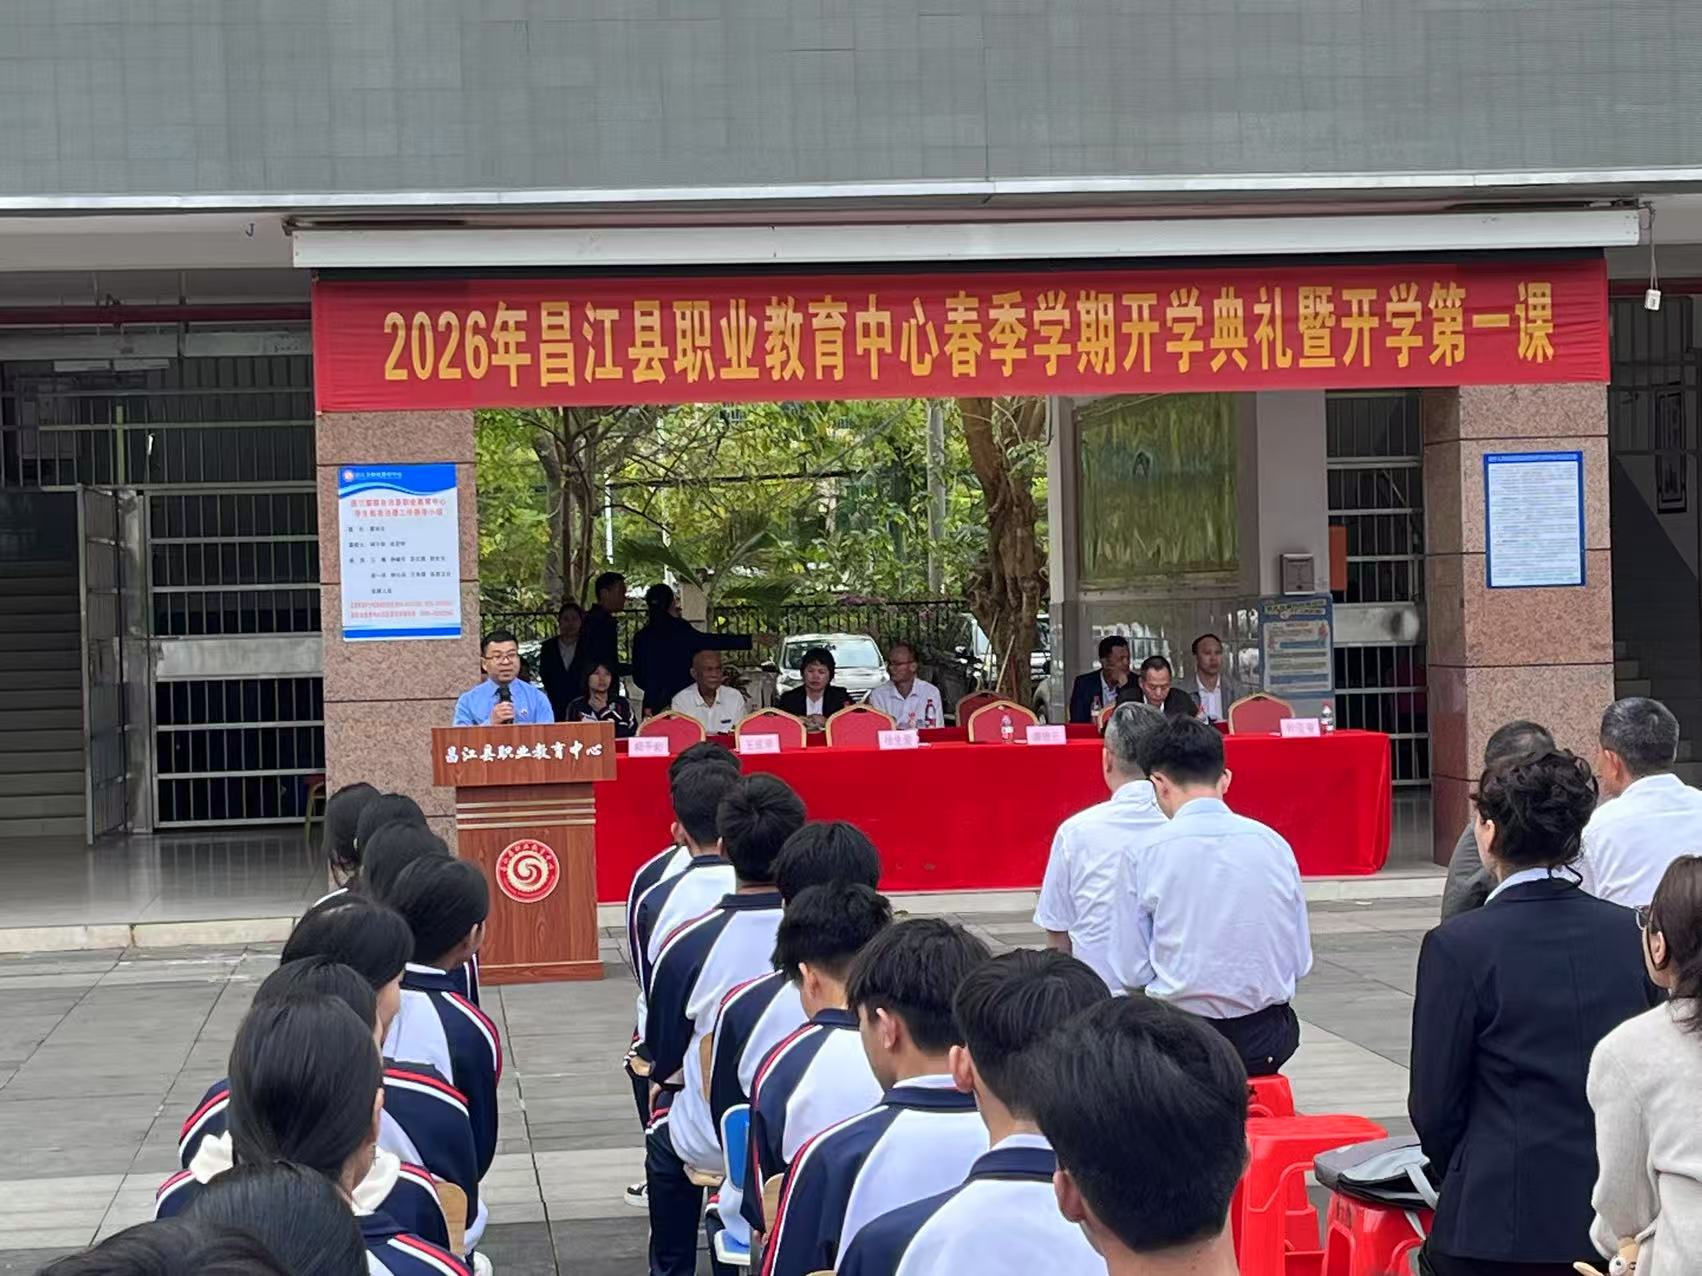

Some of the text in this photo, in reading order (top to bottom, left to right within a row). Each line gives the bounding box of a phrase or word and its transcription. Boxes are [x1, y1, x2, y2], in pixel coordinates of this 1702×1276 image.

[384, 281, 1556, 388] 2026年昌江县职业教育中心春季学期开学典礼暨开学第一课
[445, 740, 603, 764] 昌江县职业教育中心
